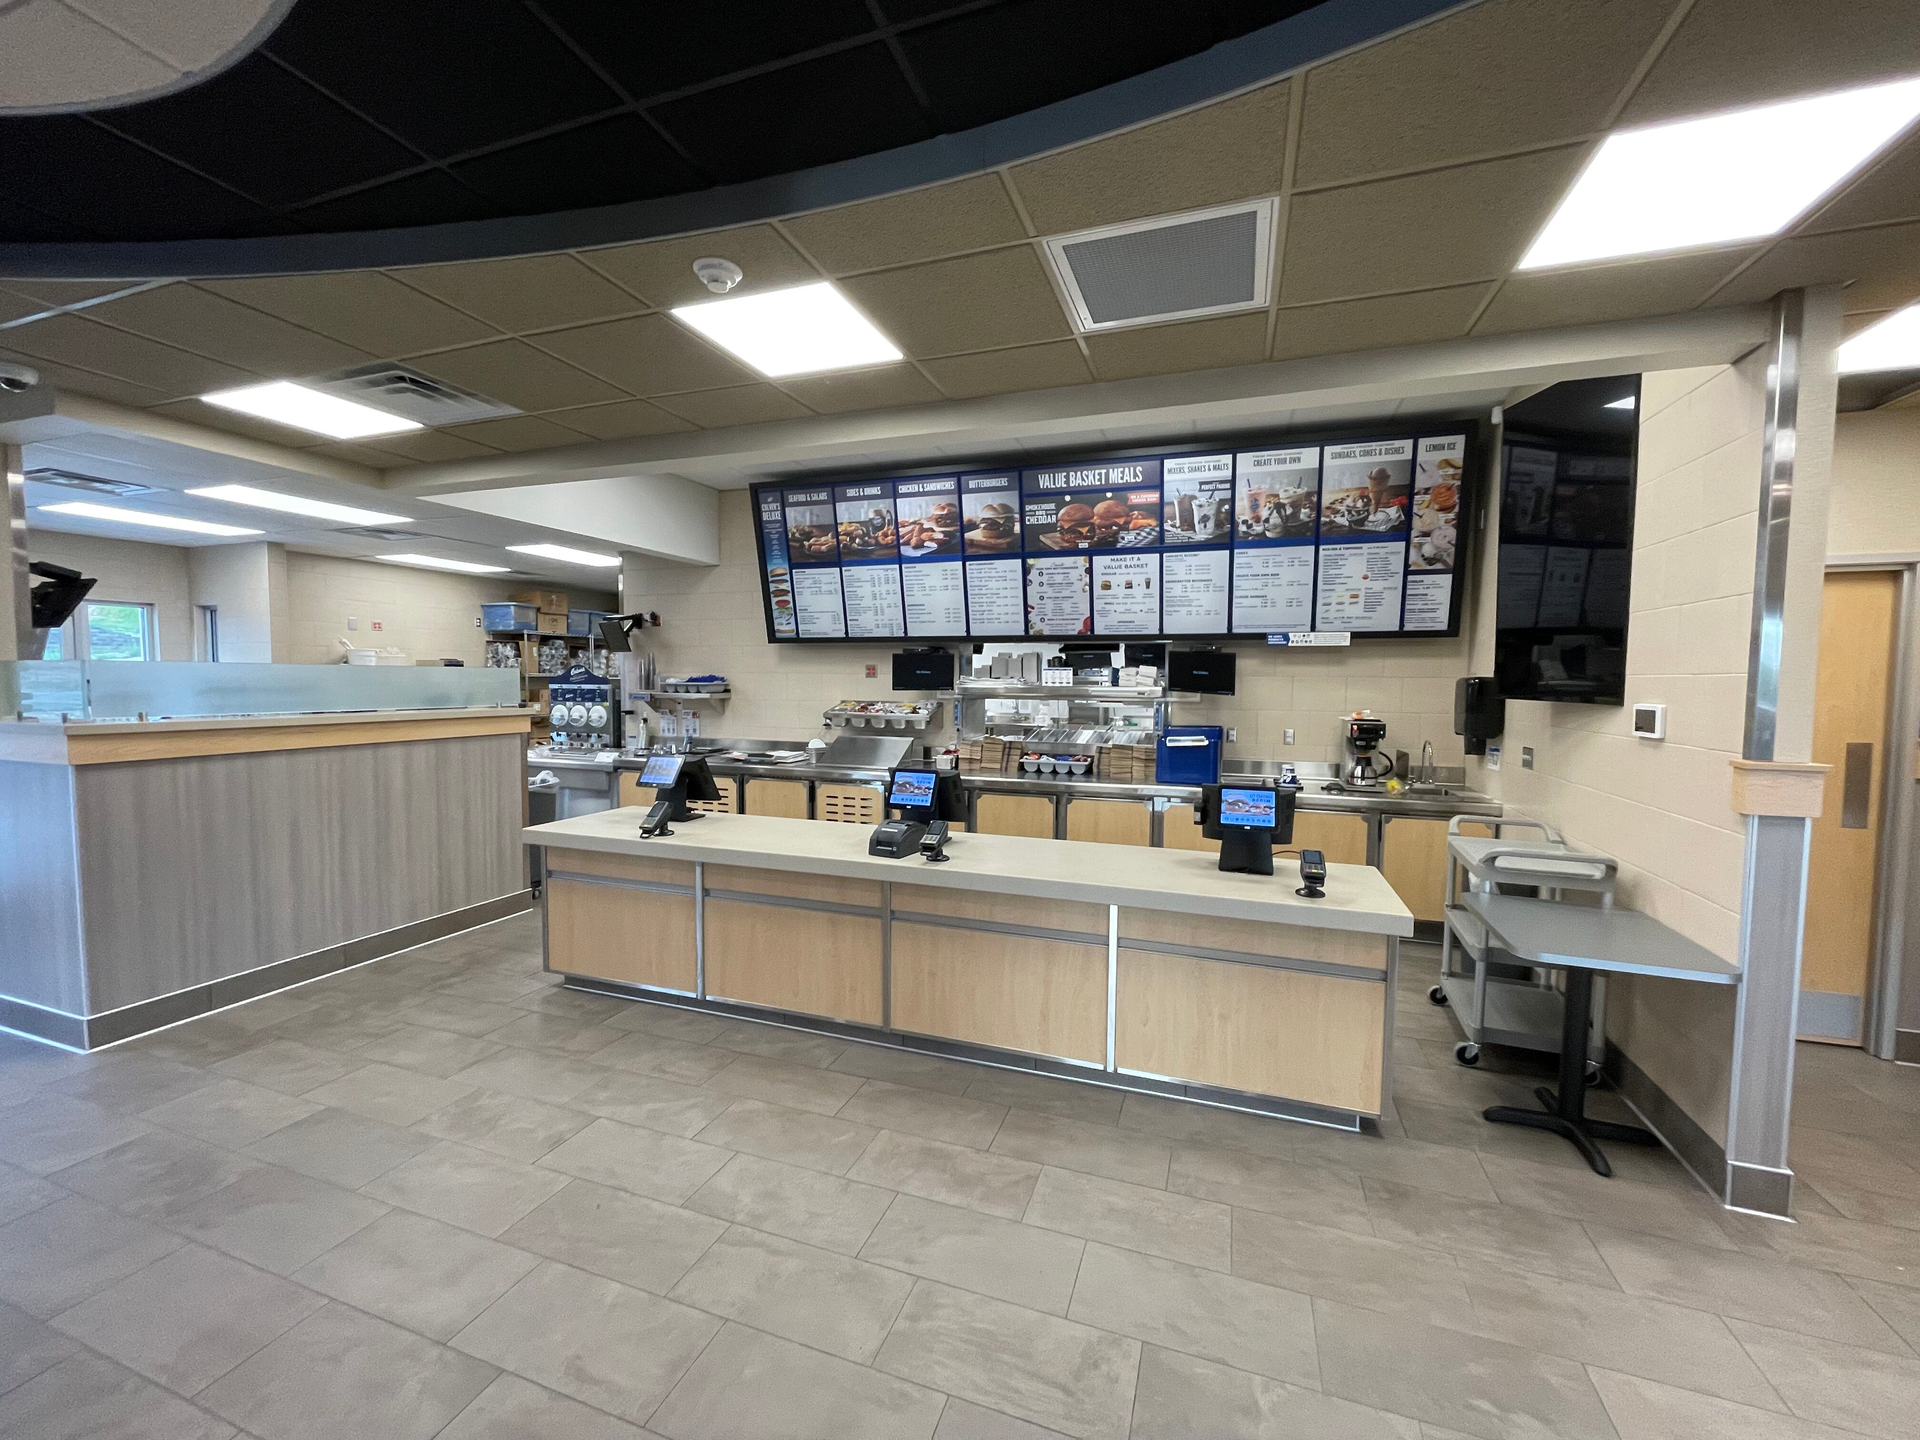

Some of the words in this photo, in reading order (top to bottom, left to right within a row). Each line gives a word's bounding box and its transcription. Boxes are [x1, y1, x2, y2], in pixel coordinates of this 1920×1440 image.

[1359, 449, 1378, 458] CONES
[1384, 446, 1404, 455] DISHES
[1426, 442, 1446, 452] LEMON
[1446, 442, 1457, 450] ICE
[1253, 458, 1272, 467] CREATE
[1274, 457, 1287, 465] YOUR
[1289, 456, 1301, 464] OWN
[1188, 464, 1207, 473] SHAKES
[1212, 462, 1230, 471] MALTS
[1038, 472, 1067, 489] VALUE
[1069, 469, 1107, 487] BASKET
[1109, 466, 1143, 483] MEALS
[846, 488, 859, 497] SIDES
[864, 487, 881, 495] DRINKS
[898, 484, 918, 493] CHICKEN
[924, 481, 954, 491] SANDWICHES
[788, 494, 806, 502] SEAFOOD
[811, 492, 828, 500] SALADS
[762, 511, 781, 521] DELUXE
[1025, 515, 1056, 524] CHEDDAR
